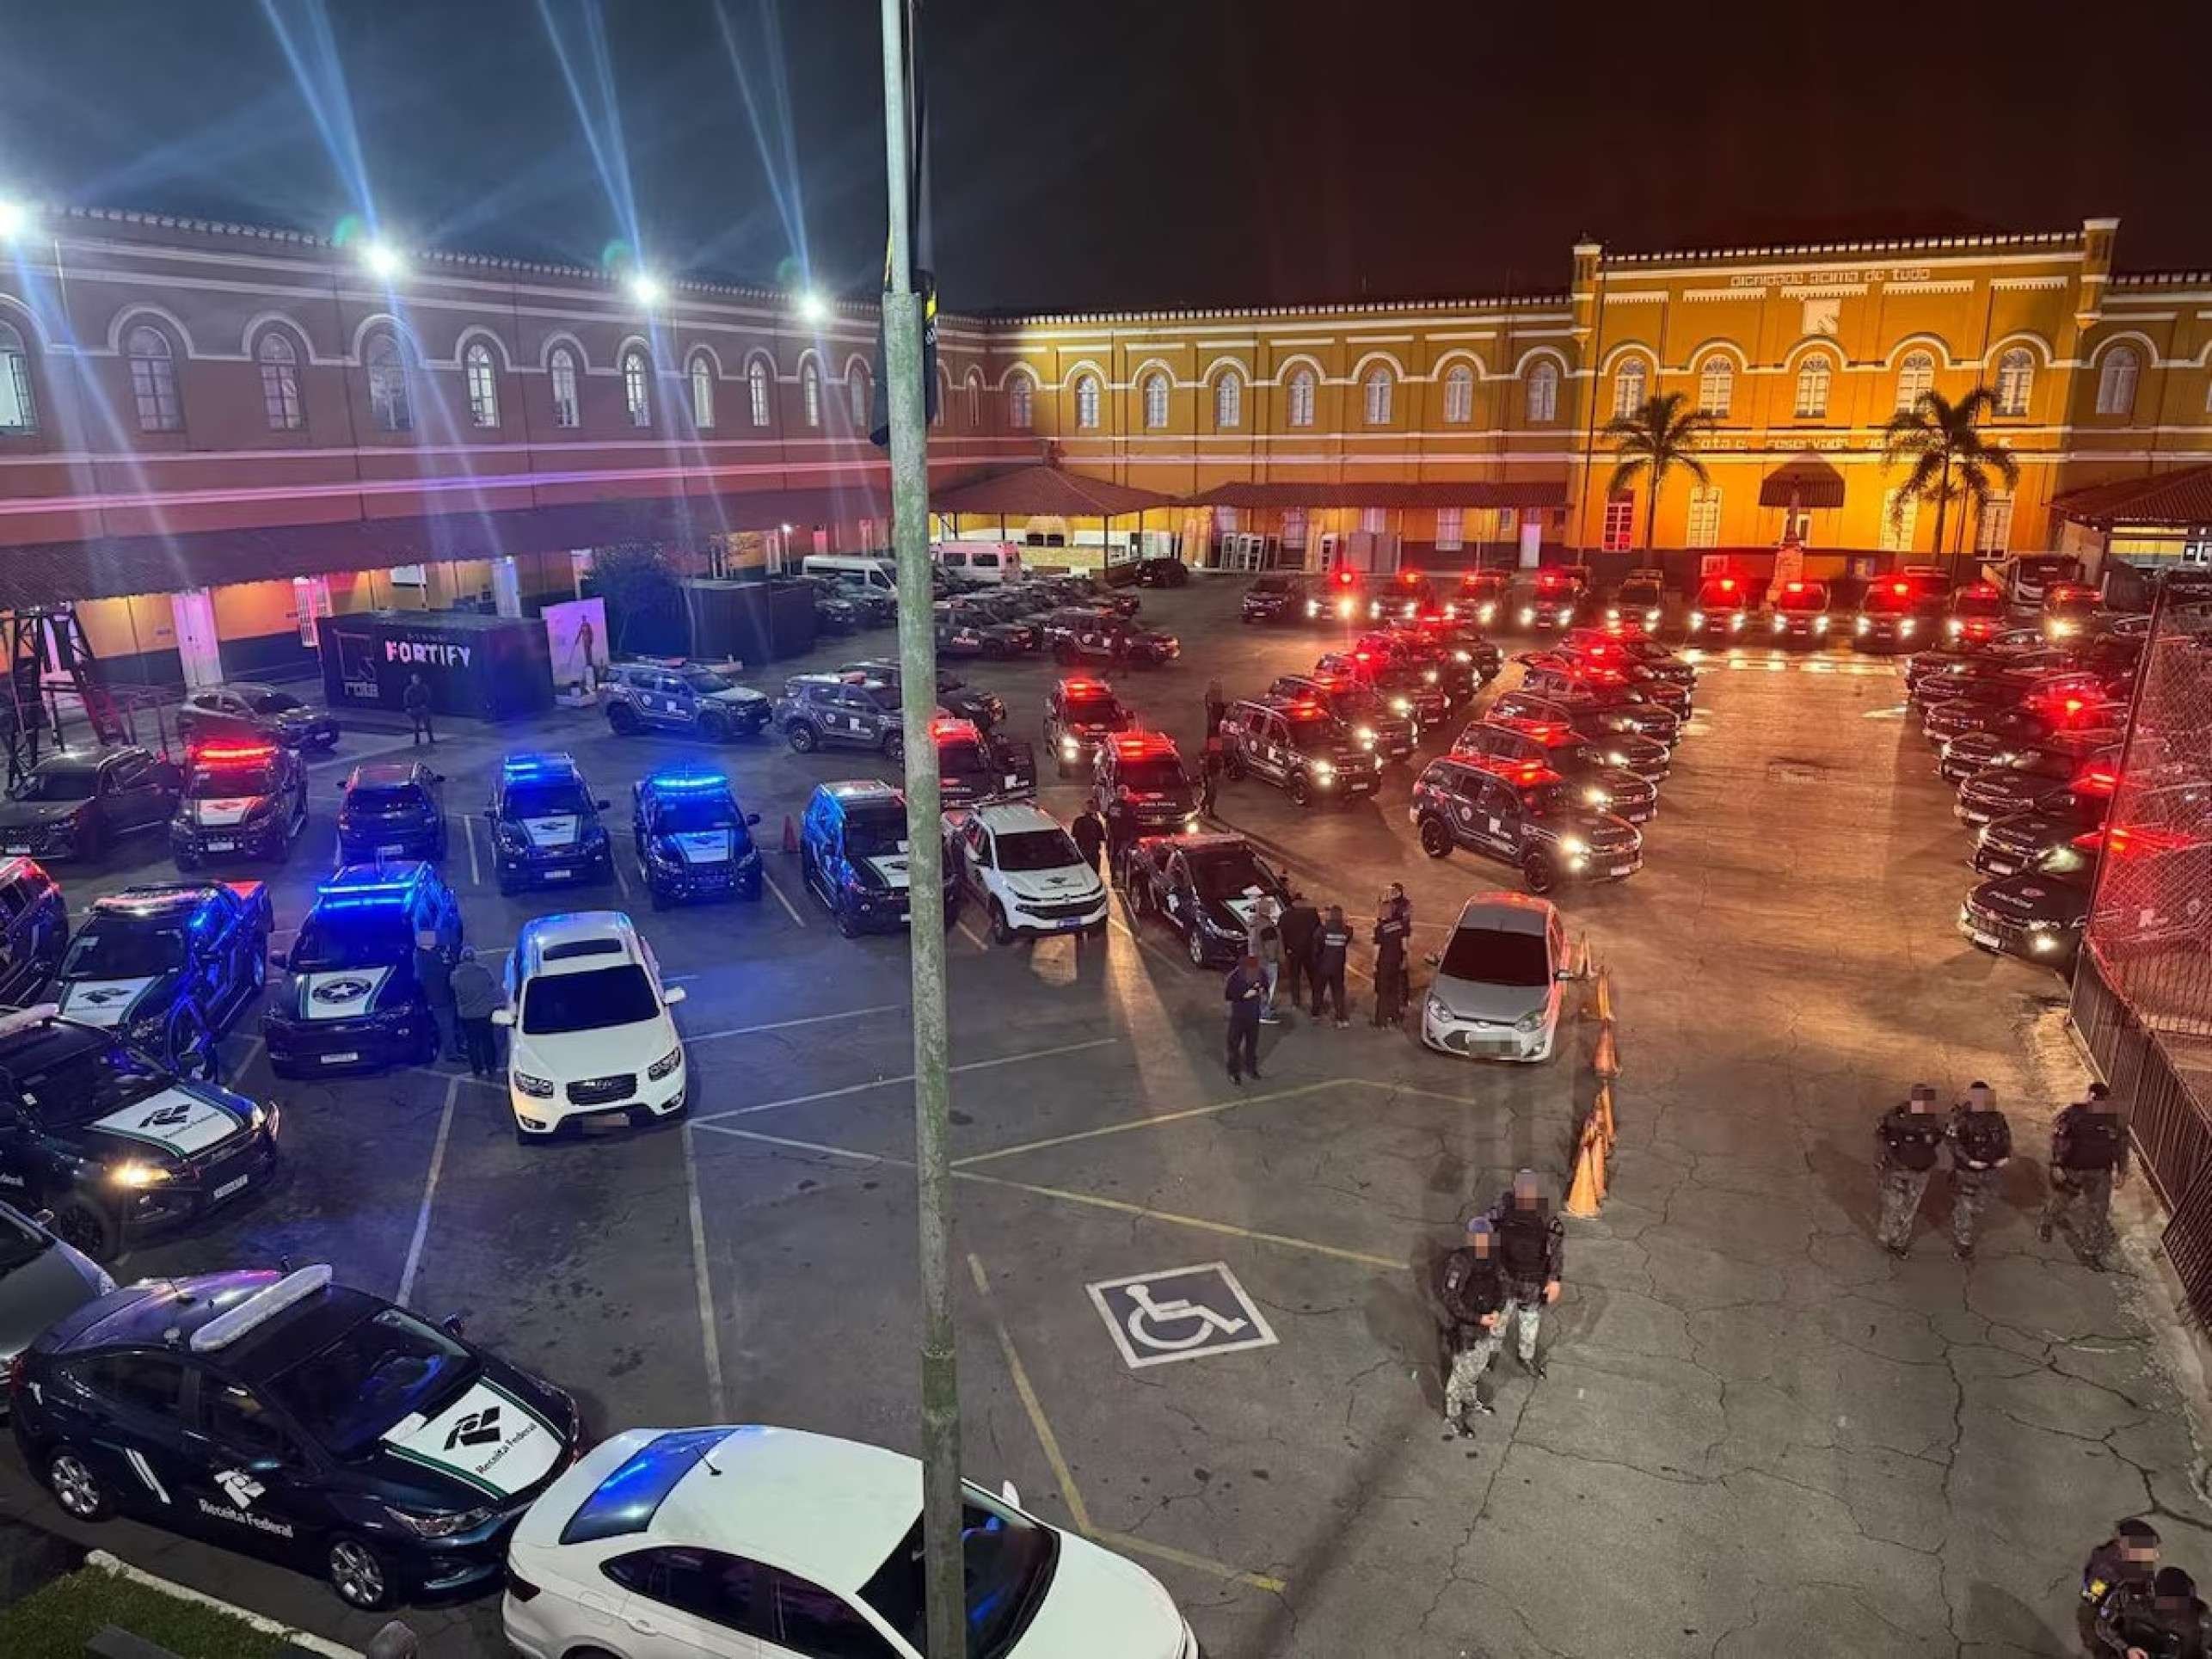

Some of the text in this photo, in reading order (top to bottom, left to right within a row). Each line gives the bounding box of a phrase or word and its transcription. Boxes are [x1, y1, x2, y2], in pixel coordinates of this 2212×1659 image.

[384, 641, 470, 667] FORTIFY
[198, 1497, 294, 1539] Receita Federal
